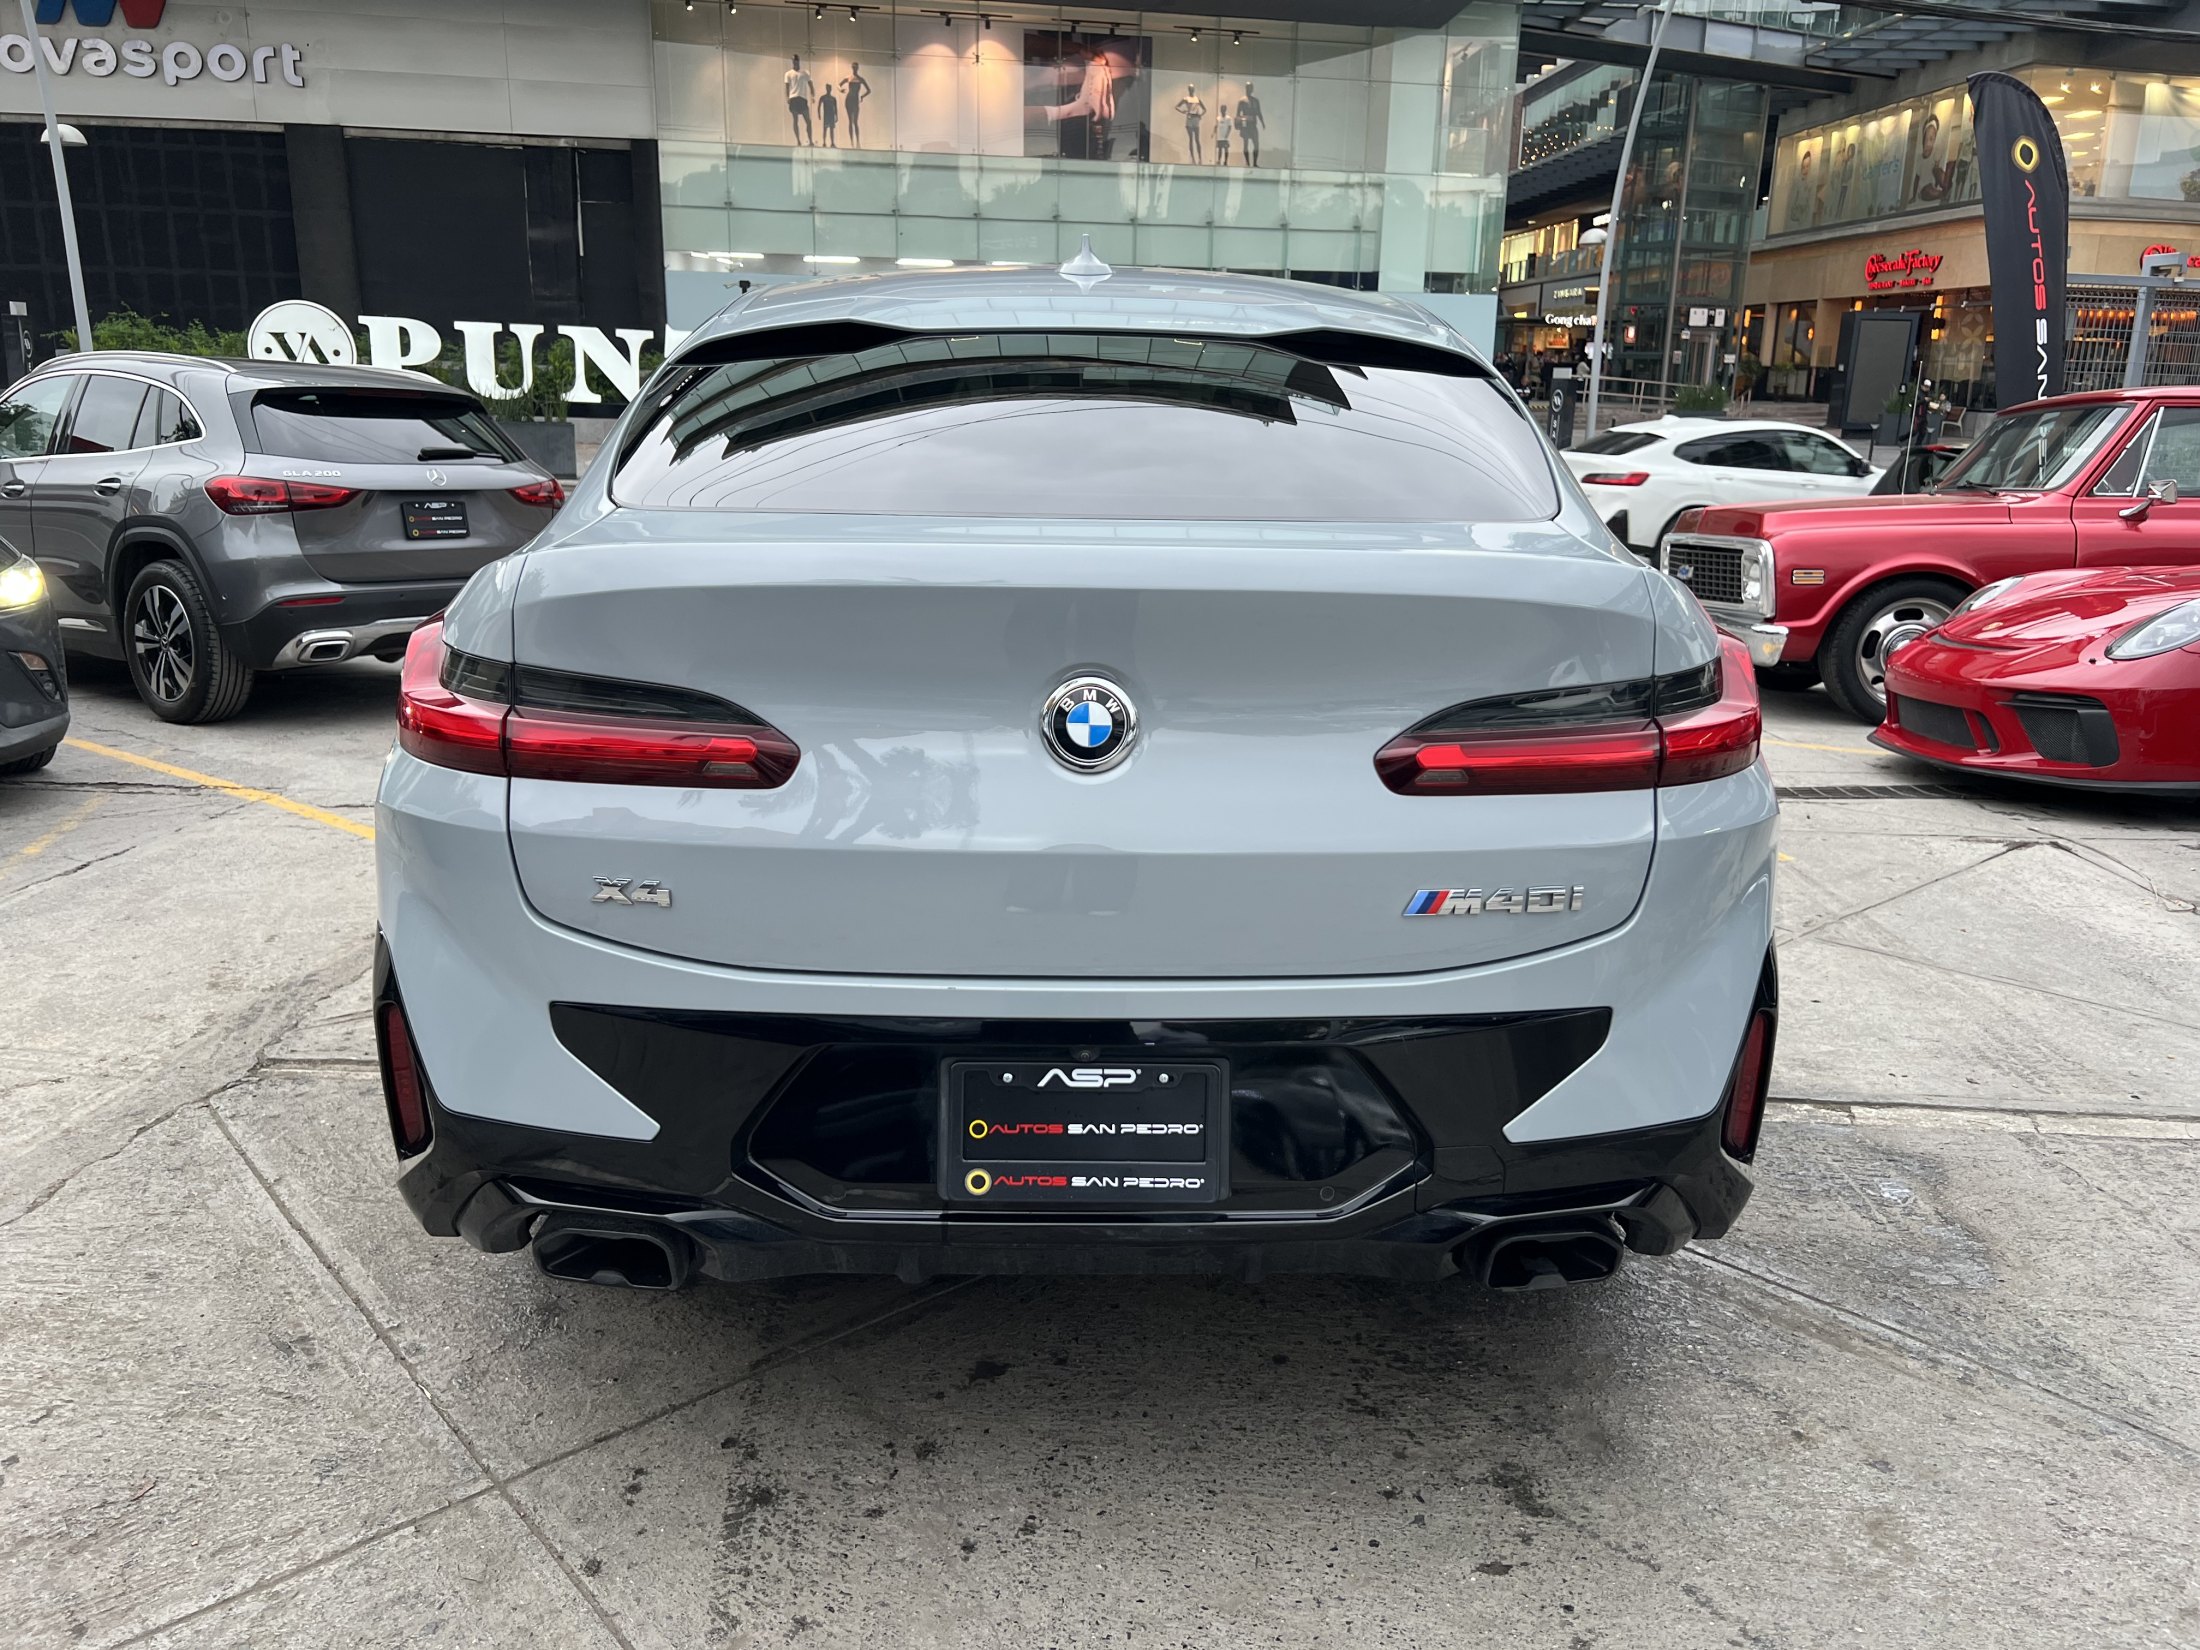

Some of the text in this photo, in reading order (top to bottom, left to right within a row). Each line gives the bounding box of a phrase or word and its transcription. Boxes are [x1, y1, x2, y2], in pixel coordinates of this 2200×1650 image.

[2024, 179, 2047, 311] AUTOS
[1545, 313, 1573, 328] Gong
[283, 470, 342, 478] GLA 200
[1060, 689, 1120, 714] BMW
[591, 875, 672, 907] X4
[1037, 1068, 1142, 1088] ASP
[988, 1123, 1204, 1135] AUTOS SAN PEDRO
[993, 1175, 1205, 1189] AUTOS SAN PEDRO
